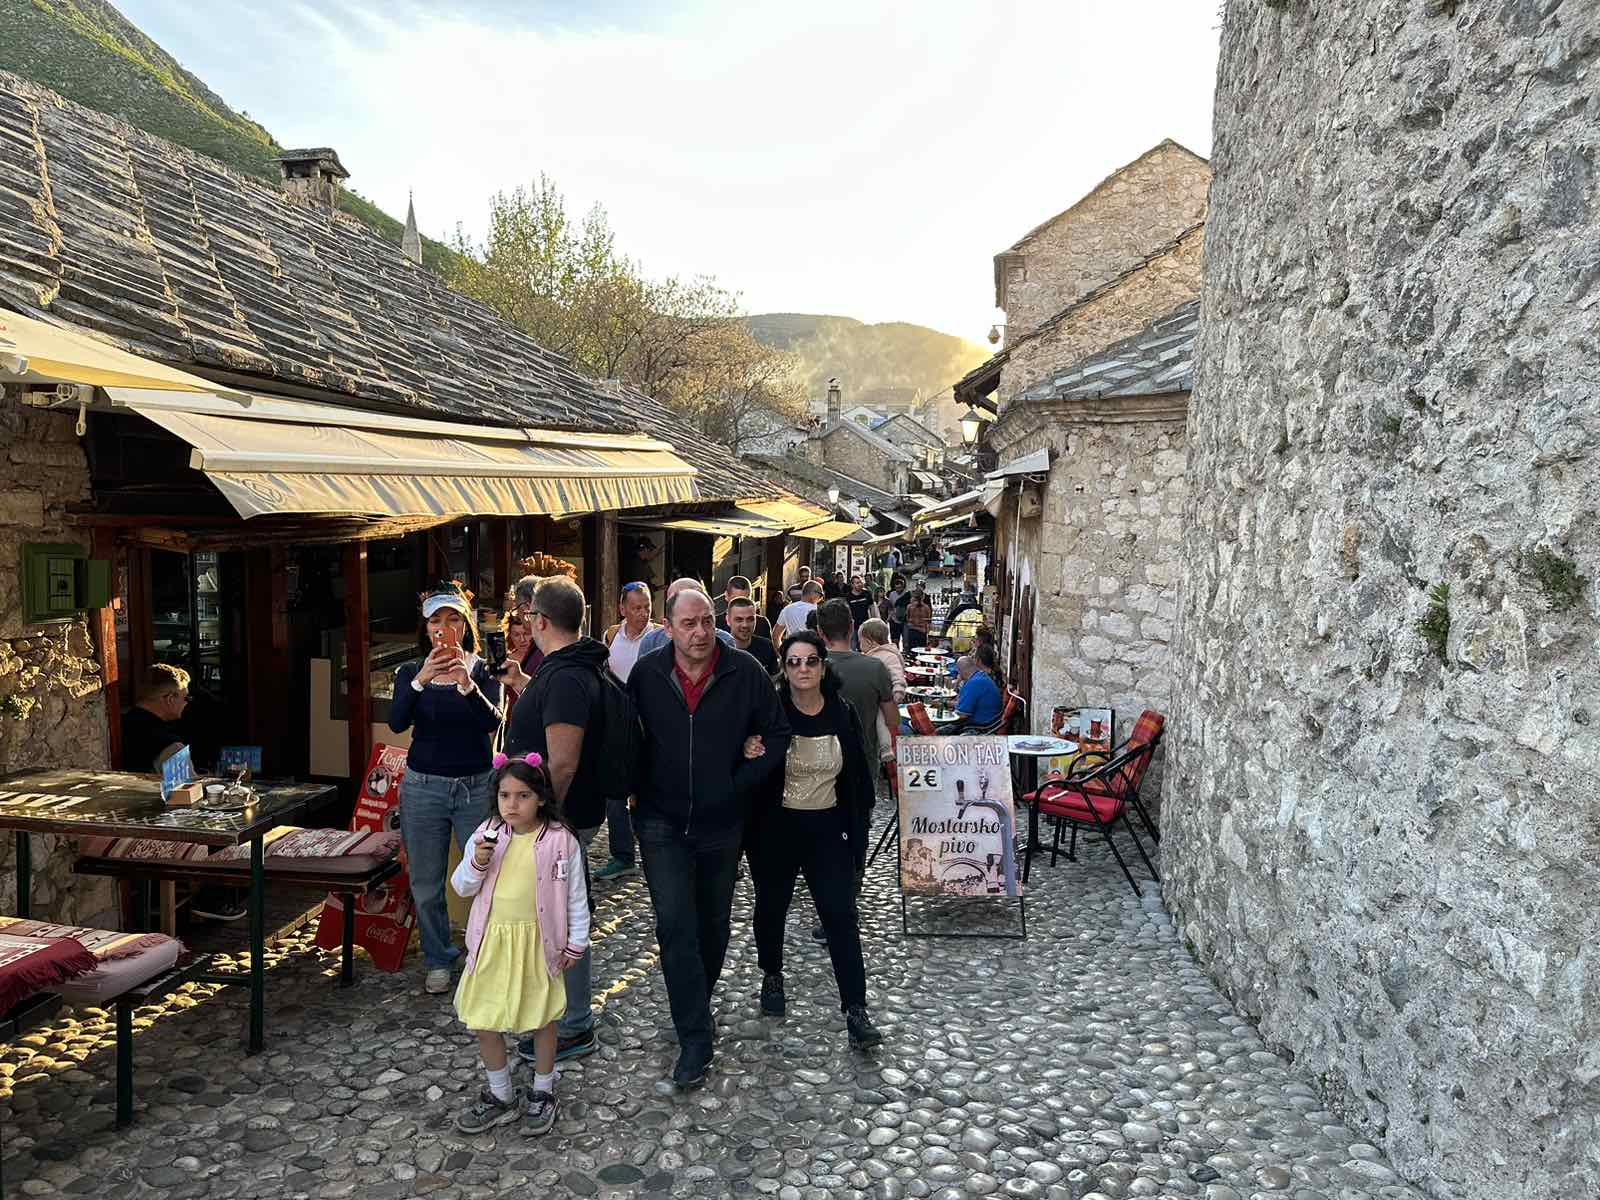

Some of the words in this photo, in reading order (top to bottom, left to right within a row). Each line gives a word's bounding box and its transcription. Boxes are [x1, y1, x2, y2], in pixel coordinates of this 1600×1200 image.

[902, 744, 939, 765] BEER
[944, 744, 969, 765] ON
[974, 744, 1003, 765] TAP
[908, 769, 938, 788] 2€
[911, 816, 1000, 834] Mostarsko
[939, 837, 976, 858] pivo
